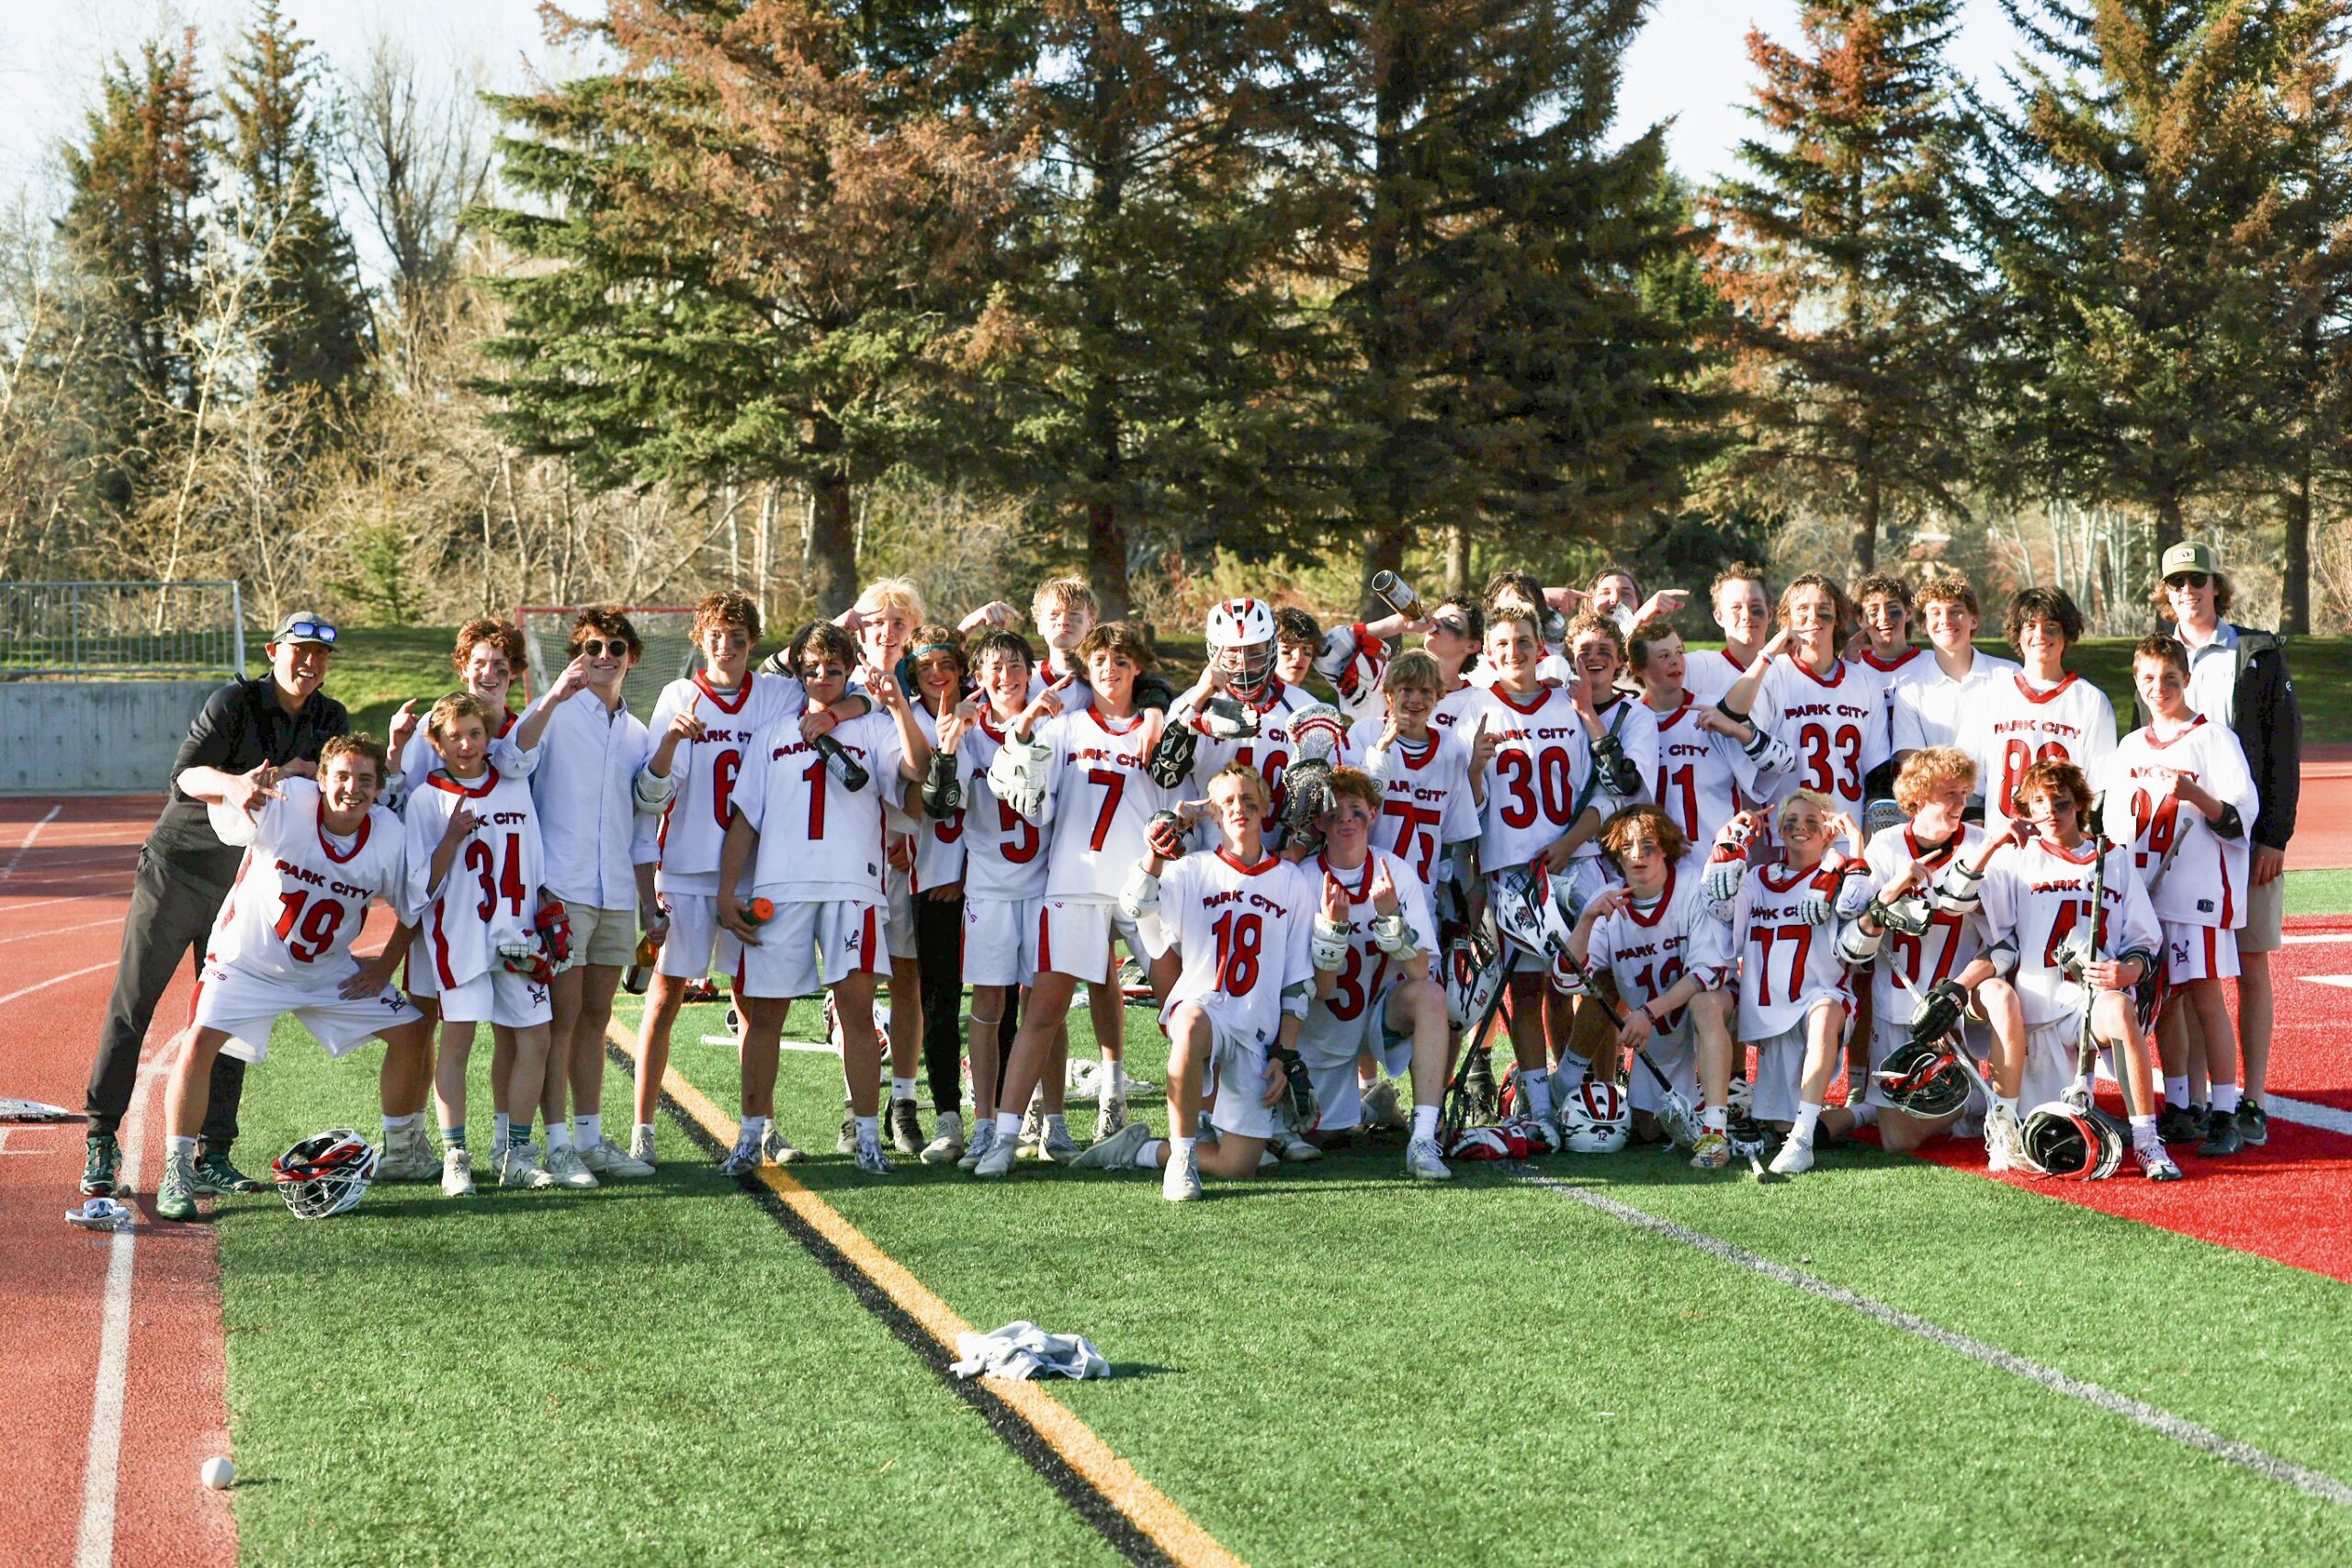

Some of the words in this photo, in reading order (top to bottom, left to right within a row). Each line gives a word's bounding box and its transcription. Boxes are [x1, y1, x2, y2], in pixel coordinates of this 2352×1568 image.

[1537, 728, 1575, 740] CITY
[1785, 704, 1830, 720] PARK
[1837, 704, 1869, 719] CITY
[1995, 719, 2036, 735] PARK
[2041, 721, 2081, 739] CITY
[1116, 753, 1145, 771] CIT
[1668, 744, 1709, 757] CITY
[1800, 722, 1862, 802] 33
[713, 749, 741, 832] 6
[802, 759, 827, 840] 1
[1089, 768, 1125, 852] 7
[1497, 746, 1573, 829] 30
[493, 811, 526, 825] CITY
[998, 798, 1040, 863] 5
[1383, 799, 1441, 885] 75
[2131, 787, 2179, 871] 24
[275, 859, 327, 888] PARK
[330, 881, 374, 899] CITY
[465, 832, 526, 924] 34
[1203, 889, 1245, 910] PARK
[1250, 894, 1287, 919] CITY
[2030, 879, 2081, 895] PARK
[274, 889, 345, 964] 19
[1615, 943, 1657, 962] PARK
[1211, 909, 1263, 998] 18
[1599, 1132, 1608, 1142] 12
